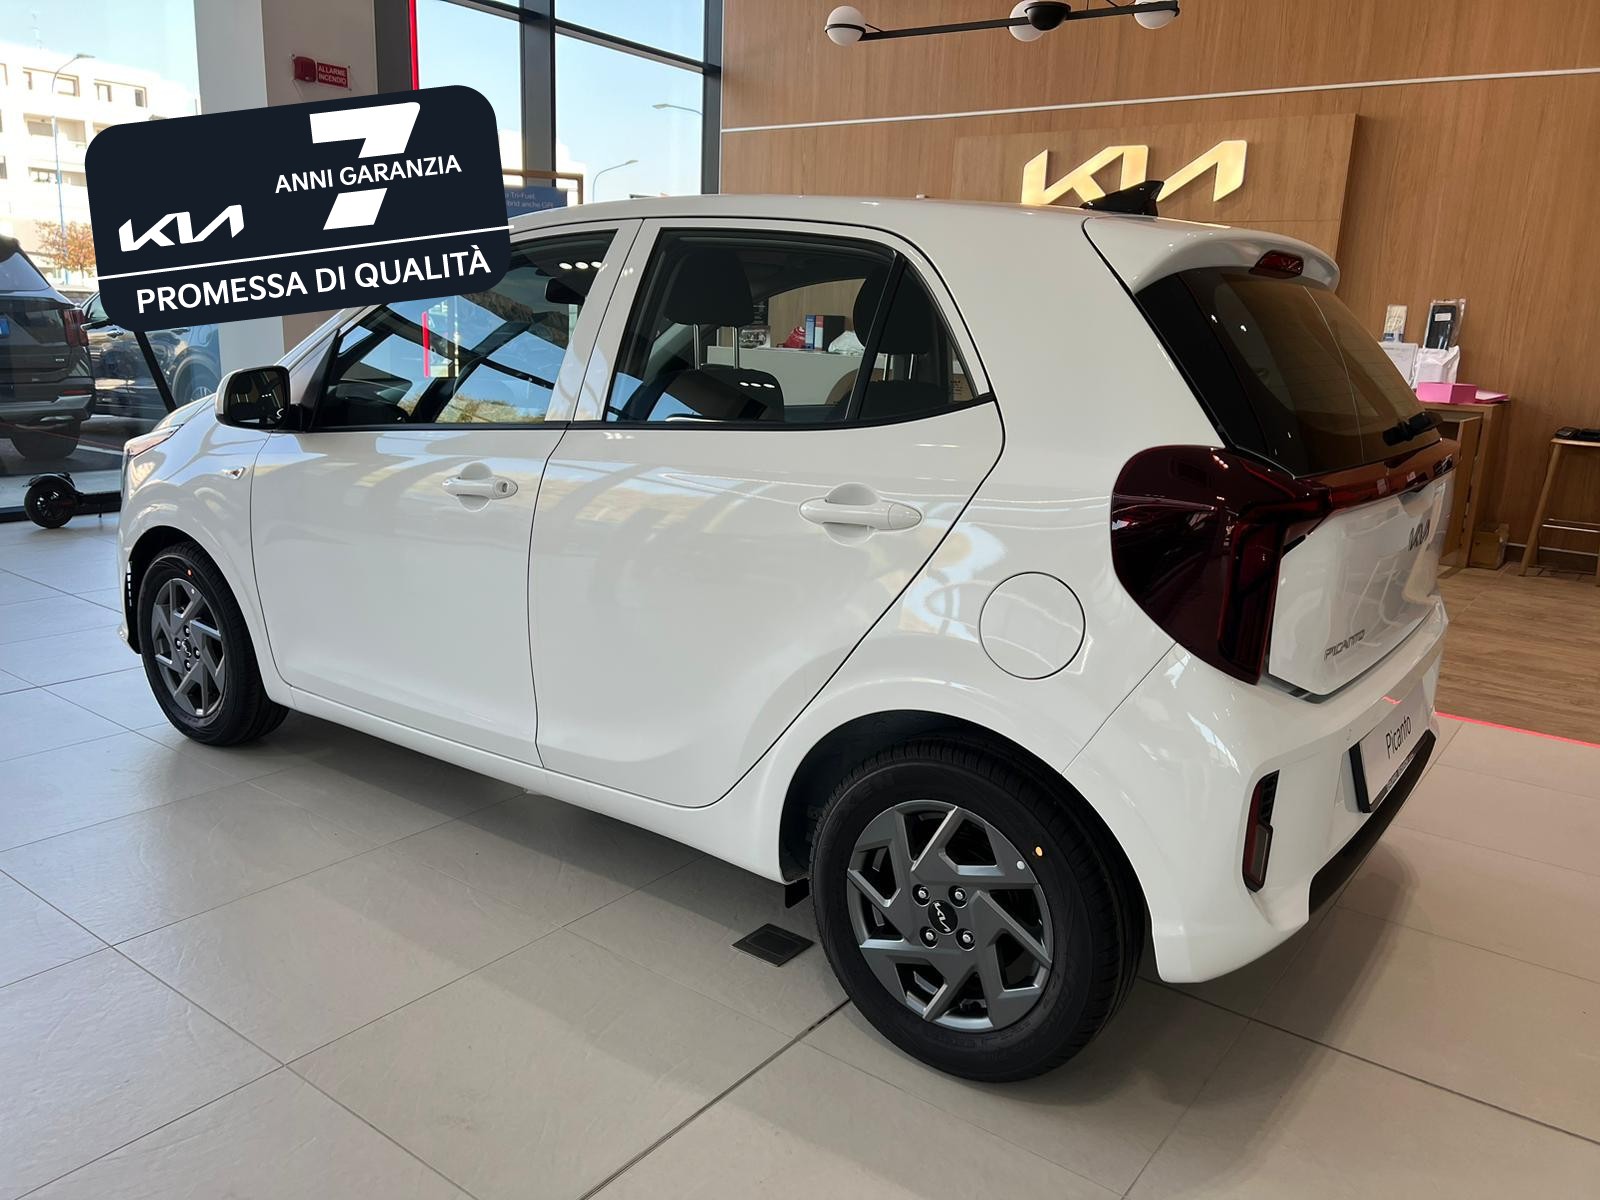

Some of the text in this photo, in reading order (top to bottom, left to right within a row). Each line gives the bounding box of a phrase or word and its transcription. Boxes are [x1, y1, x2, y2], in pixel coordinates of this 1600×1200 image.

[318, 65, 346, 77] ALLARME
[318, 73, 347, 84] INCENDIO
[1324, 628, 1366, 661] PICANTO
[1385, 715, 1412, 759] Picanto
